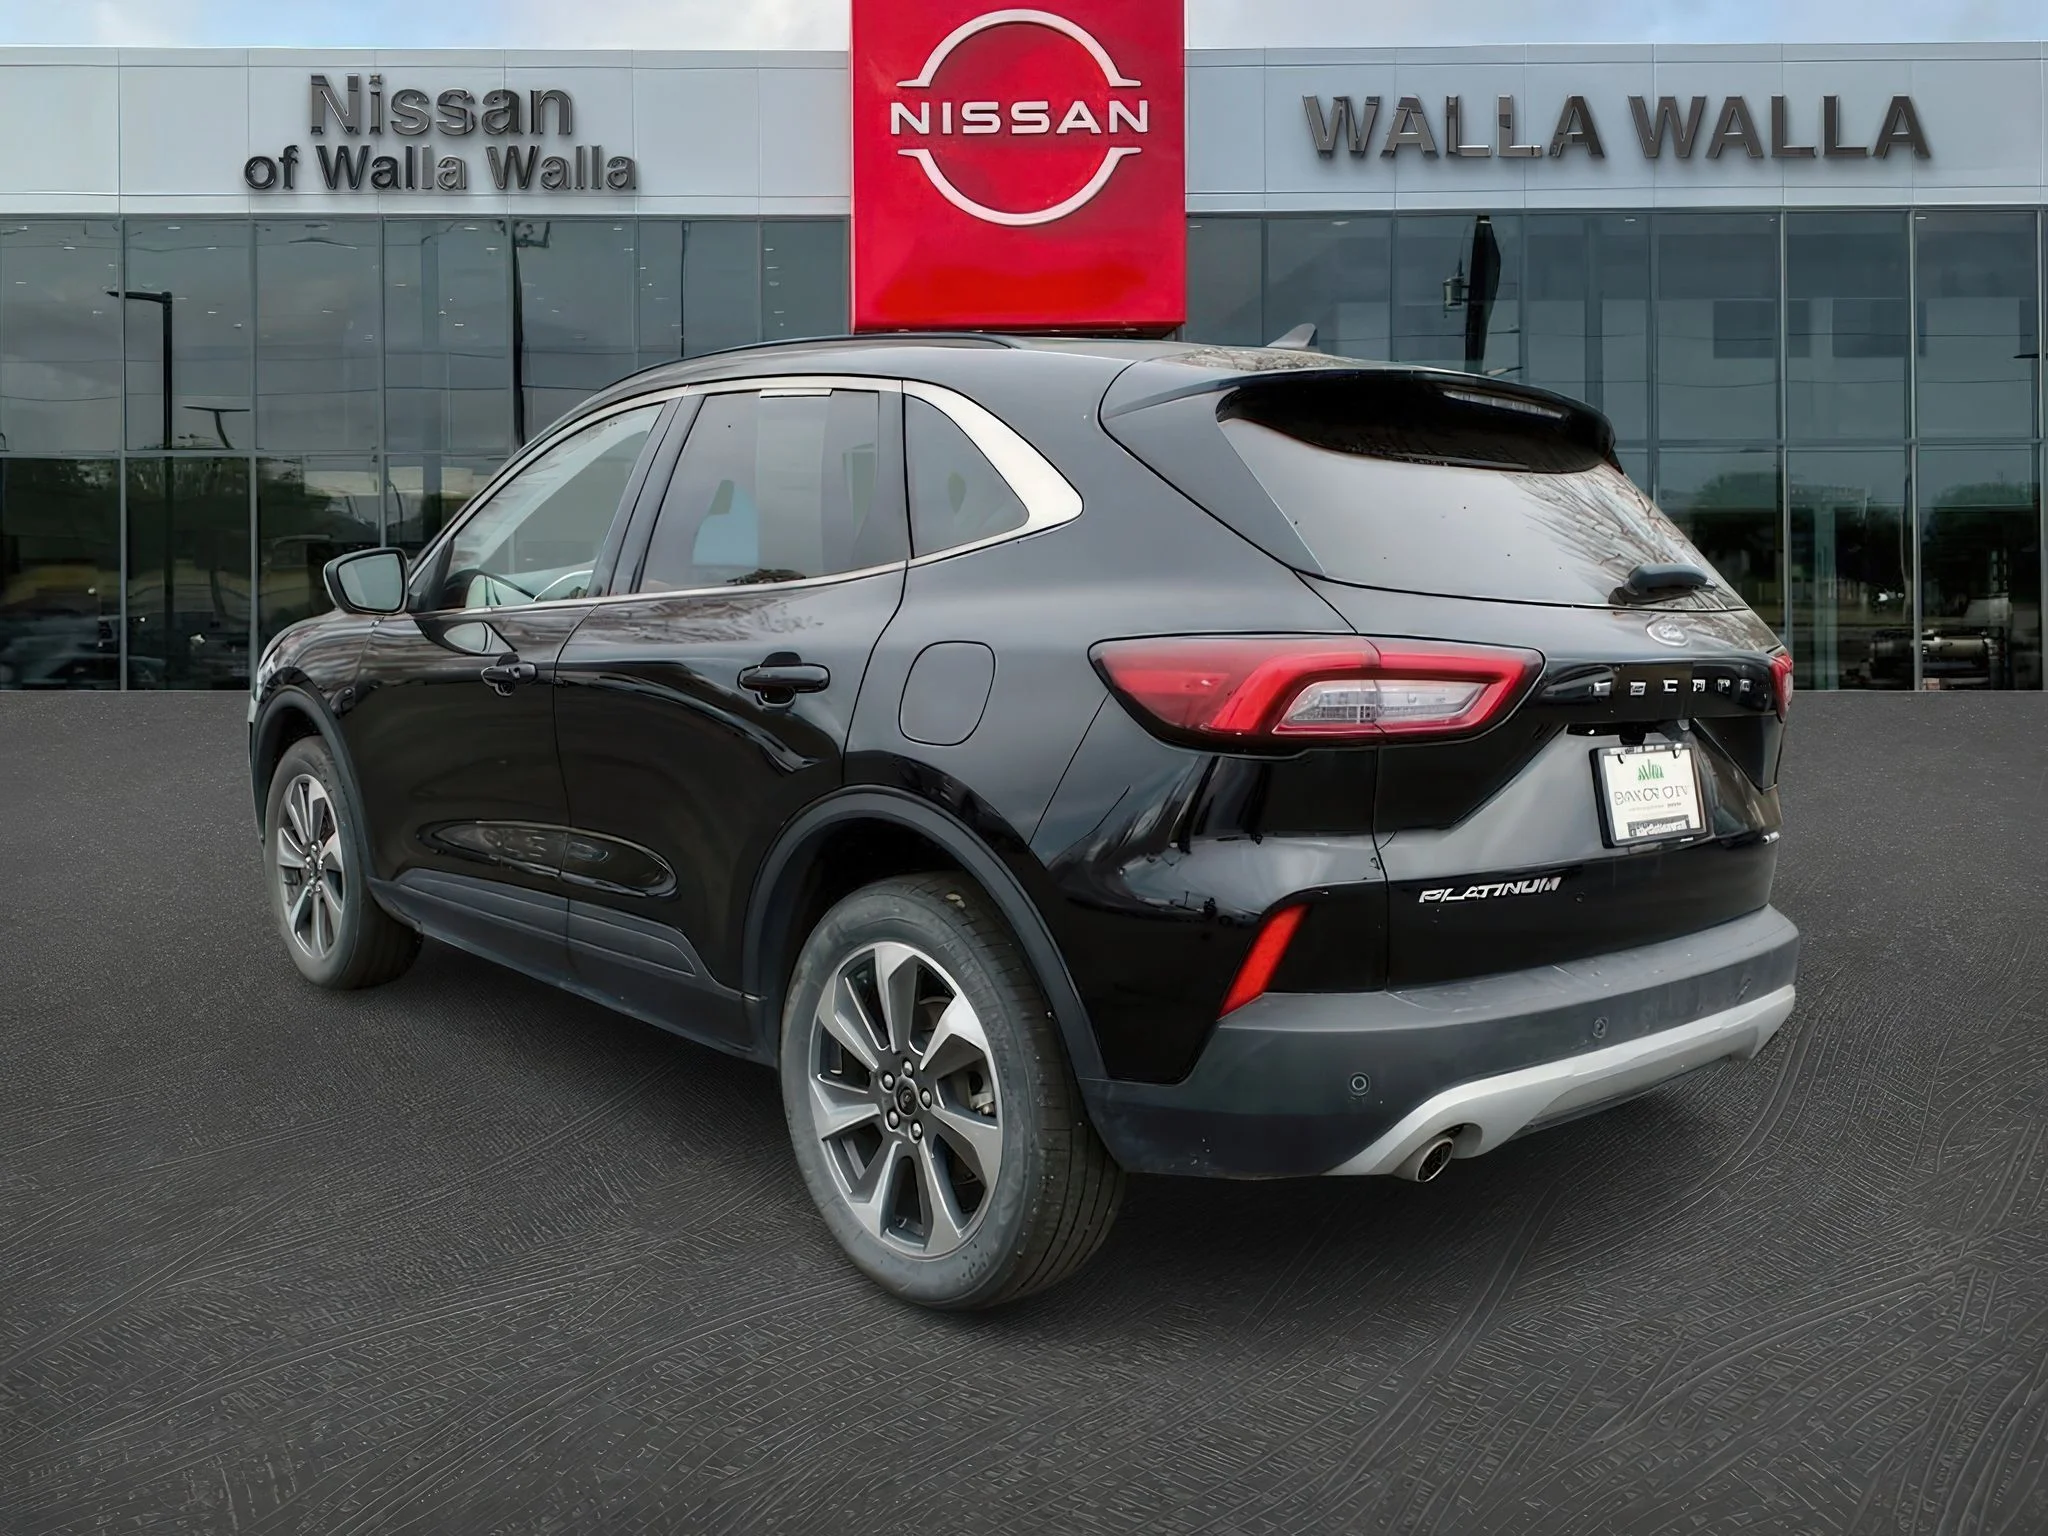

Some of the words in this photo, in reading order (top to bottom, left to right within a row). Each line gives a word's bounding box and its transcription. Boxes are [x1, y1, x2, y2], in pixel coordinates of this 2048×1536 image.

[310, 73, 574, 135] Nissan
[890, 100, 1148, 135] NISSAN
[1300, 94, 1605, 159] WALLA
[1627, 94, 1931, 159] WALLA
[243, 144, 301, 190] of
[315, 144, 468, 190] Walla
[485, 144, 637, 190] Walla
[1418, 876, 1562, 903] PLATINUM
